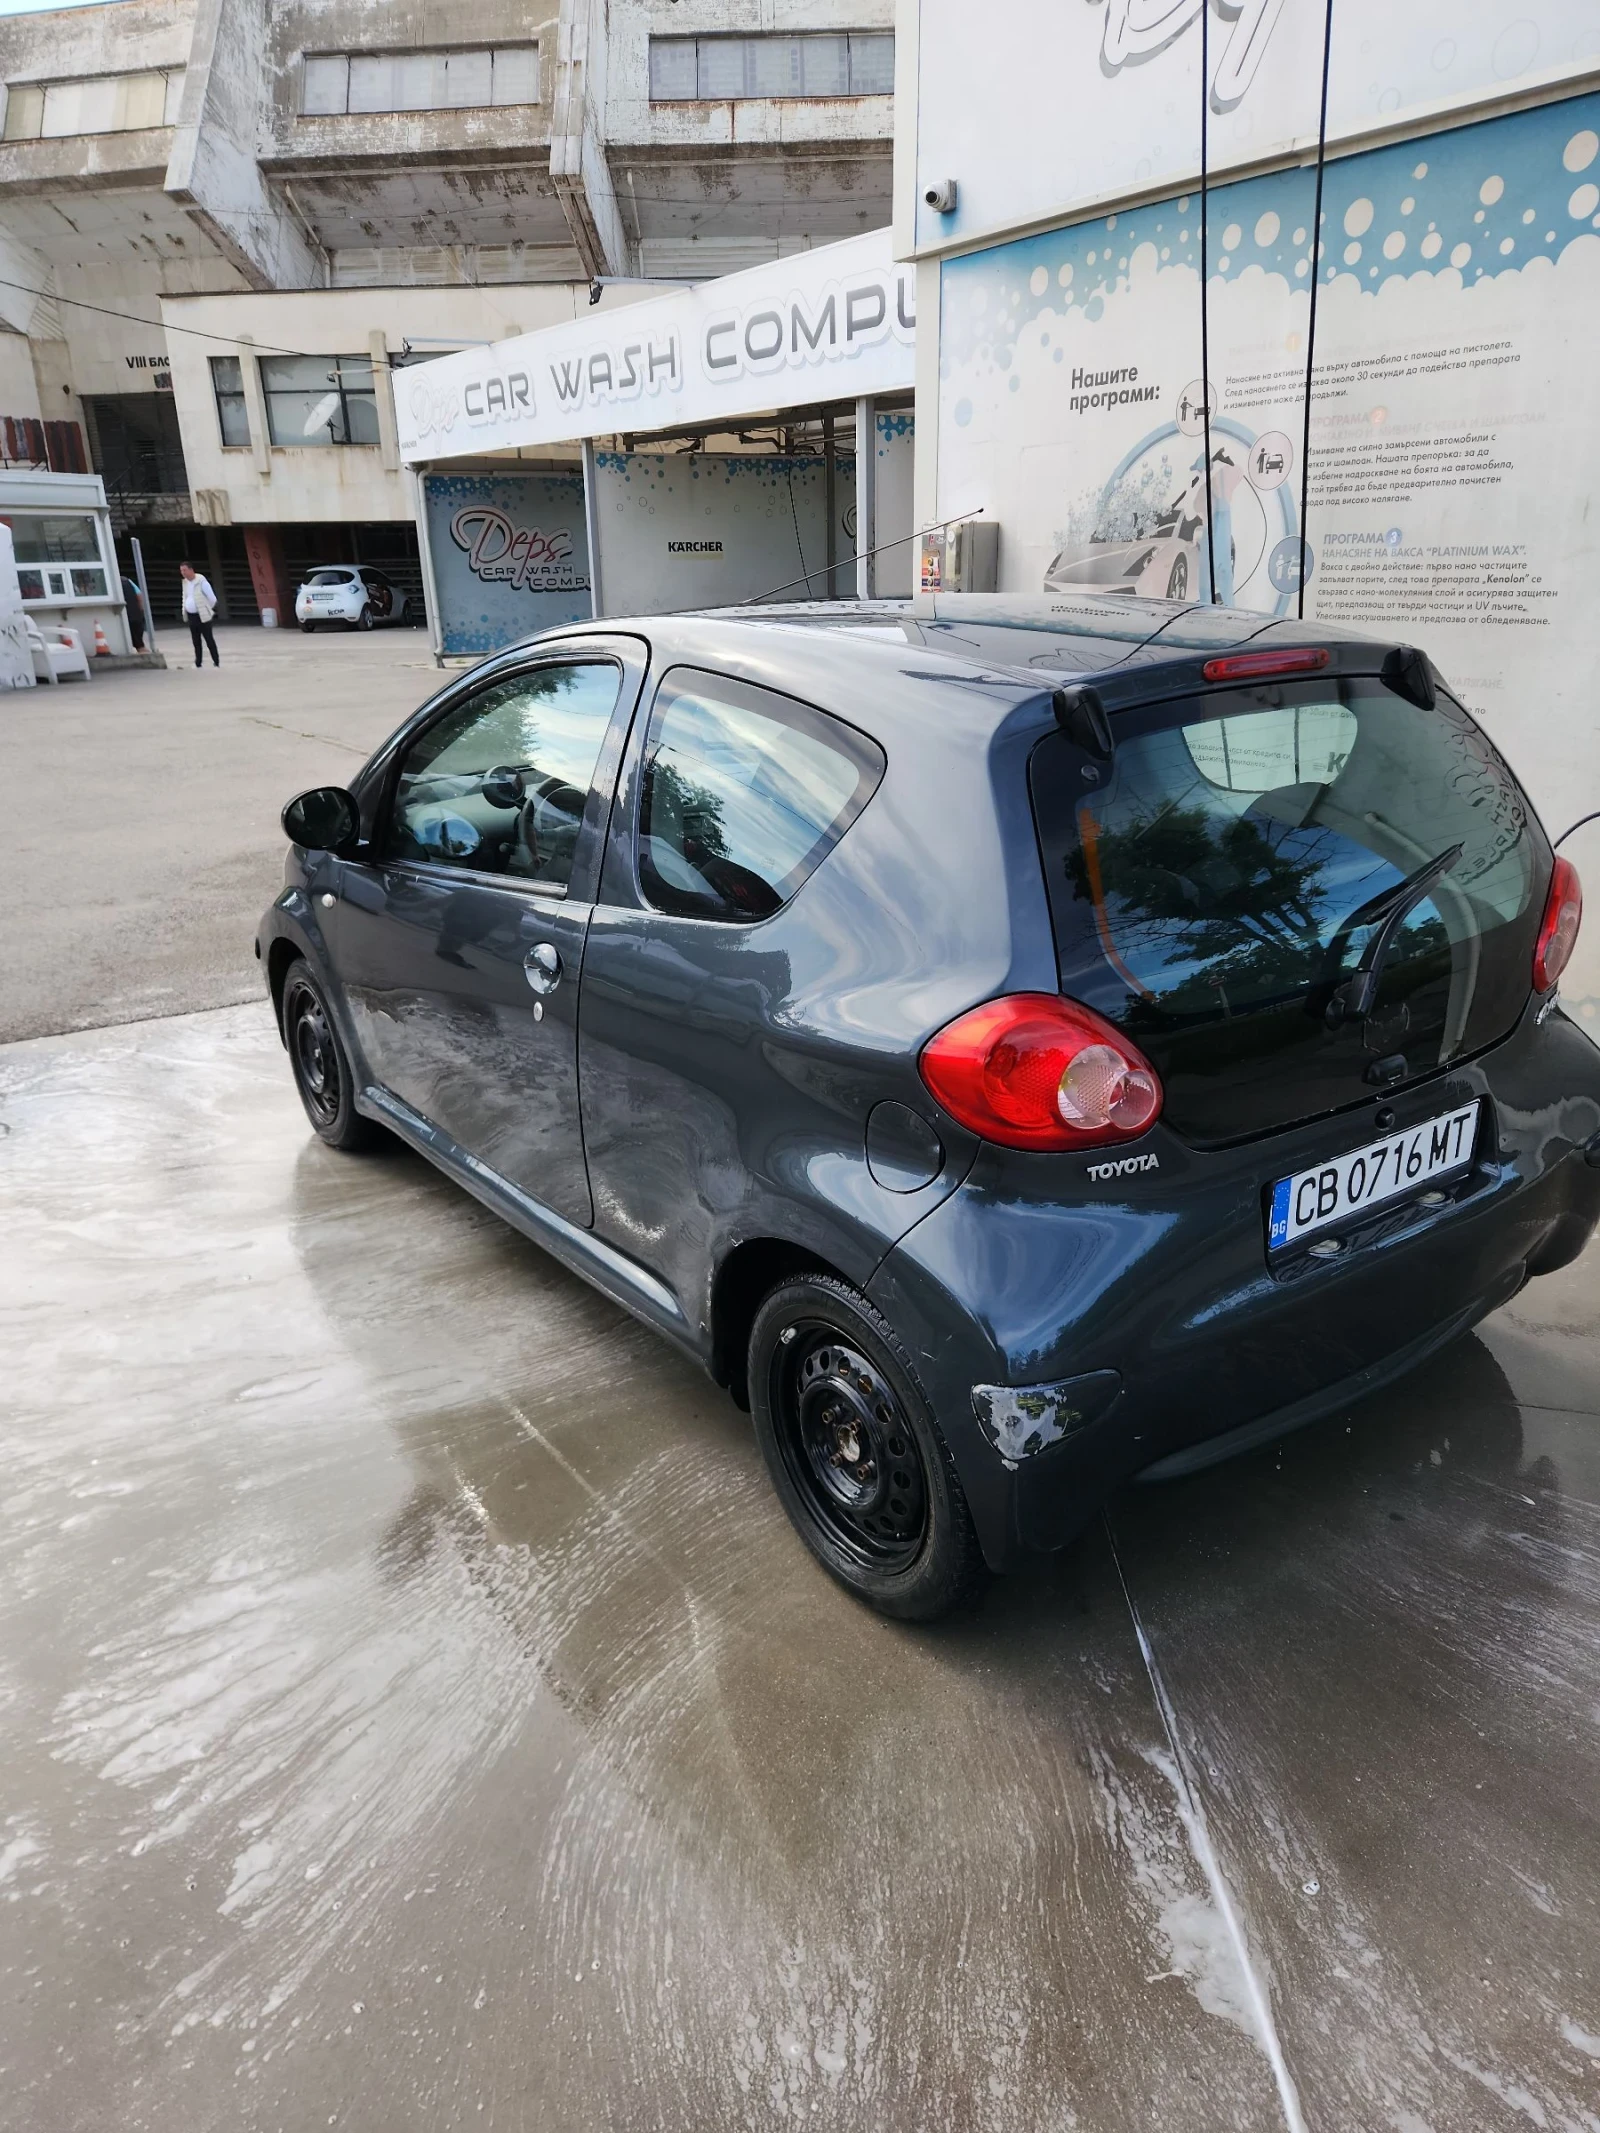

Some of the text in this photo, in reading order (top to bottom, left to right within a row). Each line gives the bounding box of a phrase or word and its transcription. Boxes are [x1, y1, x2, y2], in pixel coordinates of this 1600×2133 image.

[125, 356, 147, 368] VIII
[1226, 374, 1260, 384] Нанасяне
[1273, 368, 1304, 379] активна
[1326, 360, 1349, 373] върху
[1351, 354, 1402, 368] автомобила
[1411, 348, 1447, 360] помоща
[1449, 346, 1460, 355] на
[1463, 341, 1513, 354] пистолета.
[464, 371, 530, 416] CAR
[550, 336, 676, 401] WASH
[1072, 367, 1138, 390] Нашите
[1224, 387, 1243, 397] След
[1288, 382, 1297, 390] се
[1298, 378, 1329, 388] изаква
[1331, 375, 1355, 384] около
[1357, 372, 1368, 381] 30
[1370, 368, 1404, 380] секунди
[1406, 367, 1418, 376] да
[1419, 360, 1467, 373] подейства
[1469, 354, 1521, 368] препарата
[1070, 385, 1160, 414] програми:
[1273, 396, 1293, 404] може
[1295, 394, 1305, 402] да
[1309, 389, 1348, 402] родължи.
[1358, 443, 1383, 452] силно
[1384, 439, 1431, 450] замърсени
[1433, 433, 1488, 446] автомобили
[1333, 458, 1373, 467] шампоан.
[1376, 454, 1409, 464] Нашата
[1411, 450, 1462, 462] препоръка:
[1477, 449, 1489, 457] да
[1313, 471, 1343, 481] избегне
[1345, 469, 1399, 479] надраскване
[1414, 465, 1438, 474] боята
[1455, 460, 1514, 472] автомобила,
[1311, 485, 1324, 493] той
[1326, 483, 1353, 494] трябва
[1389, 478, 1456, 490] предварително
[1459, 475, 1501, 485] почистен
[1372, 495, 1412, 503] налягане.
[455, 508, 569, 583] Deps
[668, 541, 723, 552] KÄRCHER
[1324, 533, 1384, 545] ПРОГРАМА
[1322, 548, 1371, 558] НАНАСЯНЕ
[1374, 548, 1388, 557] НА
[1391, 547, 1424, 557] ВАКСА
[483, 566, 573, 576] CAR WASH
[1320, 562, 1343, 571] Вакса
[1351, 562, 1380, 571] двойно
[1382, 562, 1424, 571] действие:
[1426, 563, 1452, 572] първо
[1480, 562, 1527, 571] частиците
[533, 578, 590, 587] COMP
[1432, 576, 1480, 584] препарата
[1435, 588, 1456, 596] слой
[1466, 590, 1514, 598] осигурява
[1516, 590, 1558, 598] защитен
[1475, 601, 1490, 610] UV
[1316, 612, 1350, 620] Улеснява
[1352, 614, 1410, 623] изсушаването
[1420, 616, 1466, 624] предпазва
[1481, 615, 1550, 625] обледеняване.
[1086, 1153, 1159, 1182] TOYOTA
[1272, 1222, 1286, 1239] BG
[1347, 1134, 1421, 1204] 0716
[1429, 1113, 1471, 1171] MT
